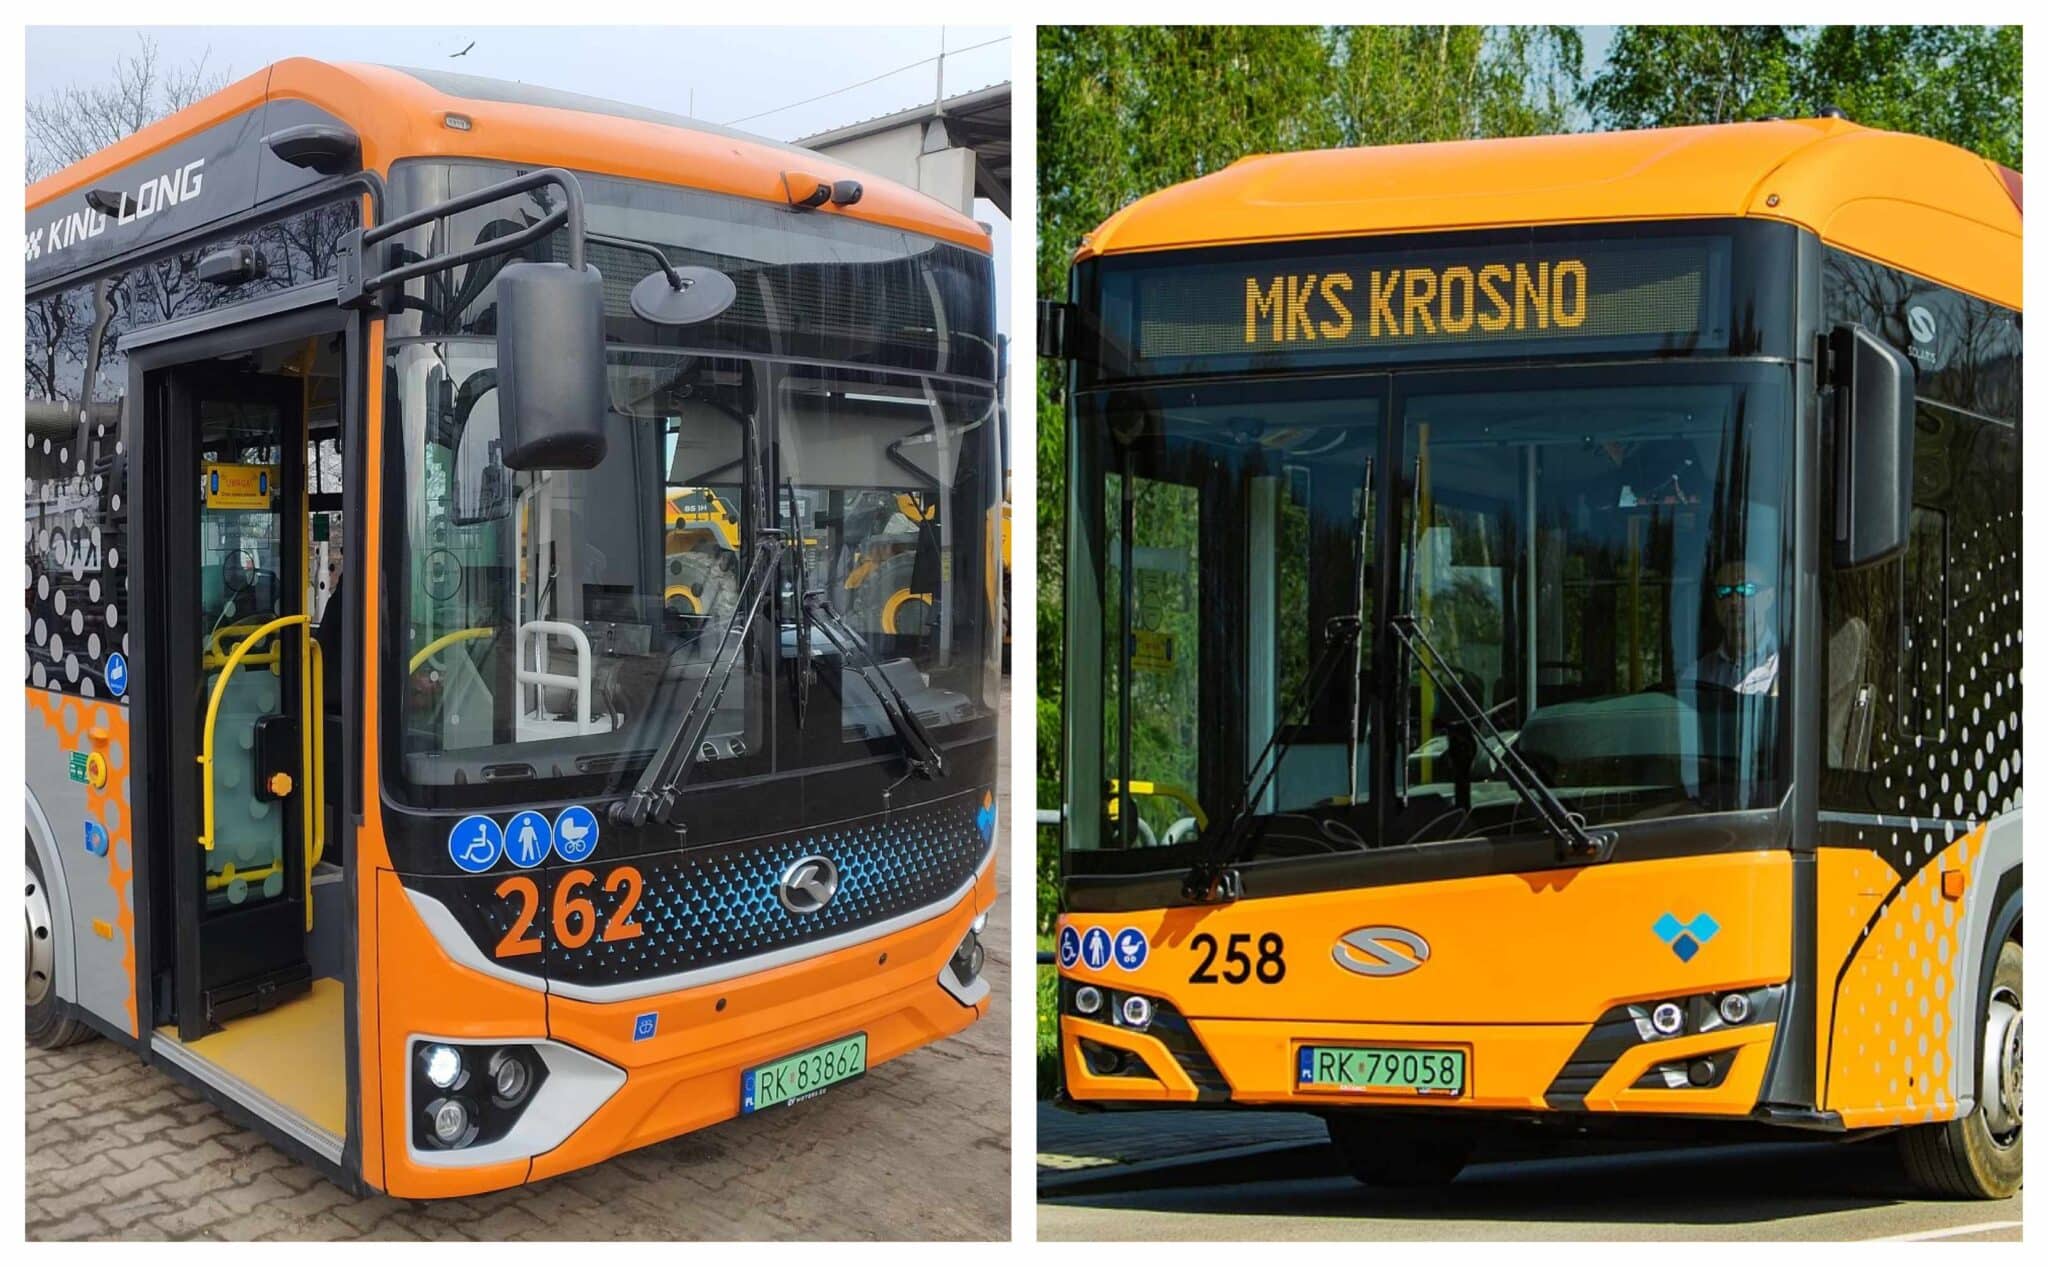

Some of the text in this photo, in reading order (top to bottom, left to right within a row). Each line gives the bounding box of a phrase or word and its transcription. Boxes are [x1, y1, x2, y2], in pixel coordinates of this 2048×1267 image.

[48, 158, 205, 254] KING LONG
[1245, 260, 1586, 343] MKS KROSNO
[494, 866, 643, 958] 262
[1188, 932, 1286, 984] 258
[761, 1043, 860, 1104] RK 83862
[1319, 1052, 1456, 1085] RK 79058
